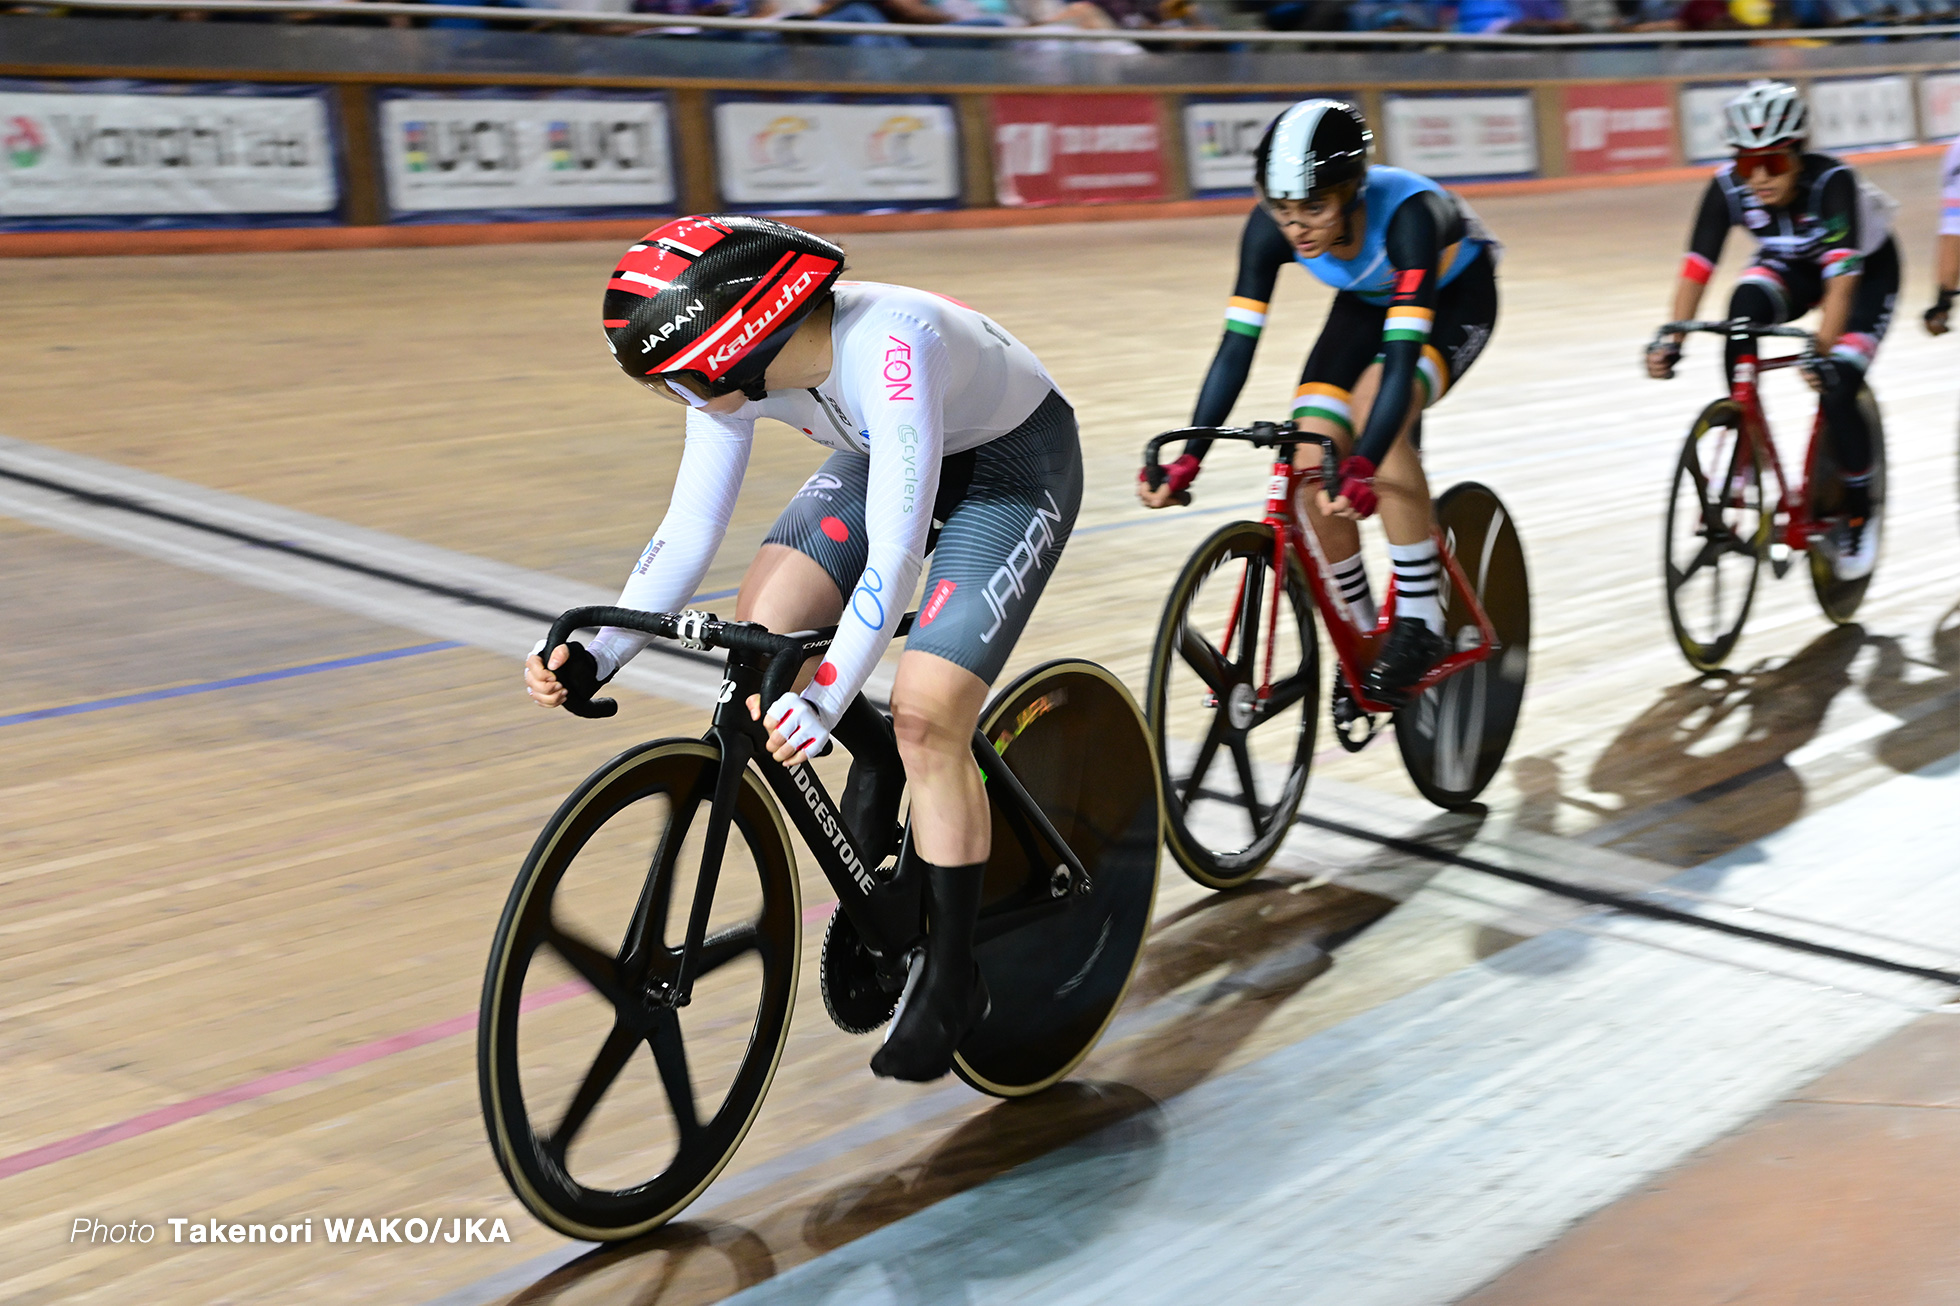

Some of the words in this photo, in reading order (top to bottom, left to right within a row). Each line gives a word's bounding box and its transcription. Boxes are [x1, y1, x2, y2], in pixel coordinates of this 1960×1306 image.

[641, 299, 704, 354] JAPAN
[707, 272, 812, 370] Kabuto
[638, 539, 665, 575] KEIRIN
[980, 489, 1062, 644] JAPAN
[788, 764, 875, 896] IDGESTONE
